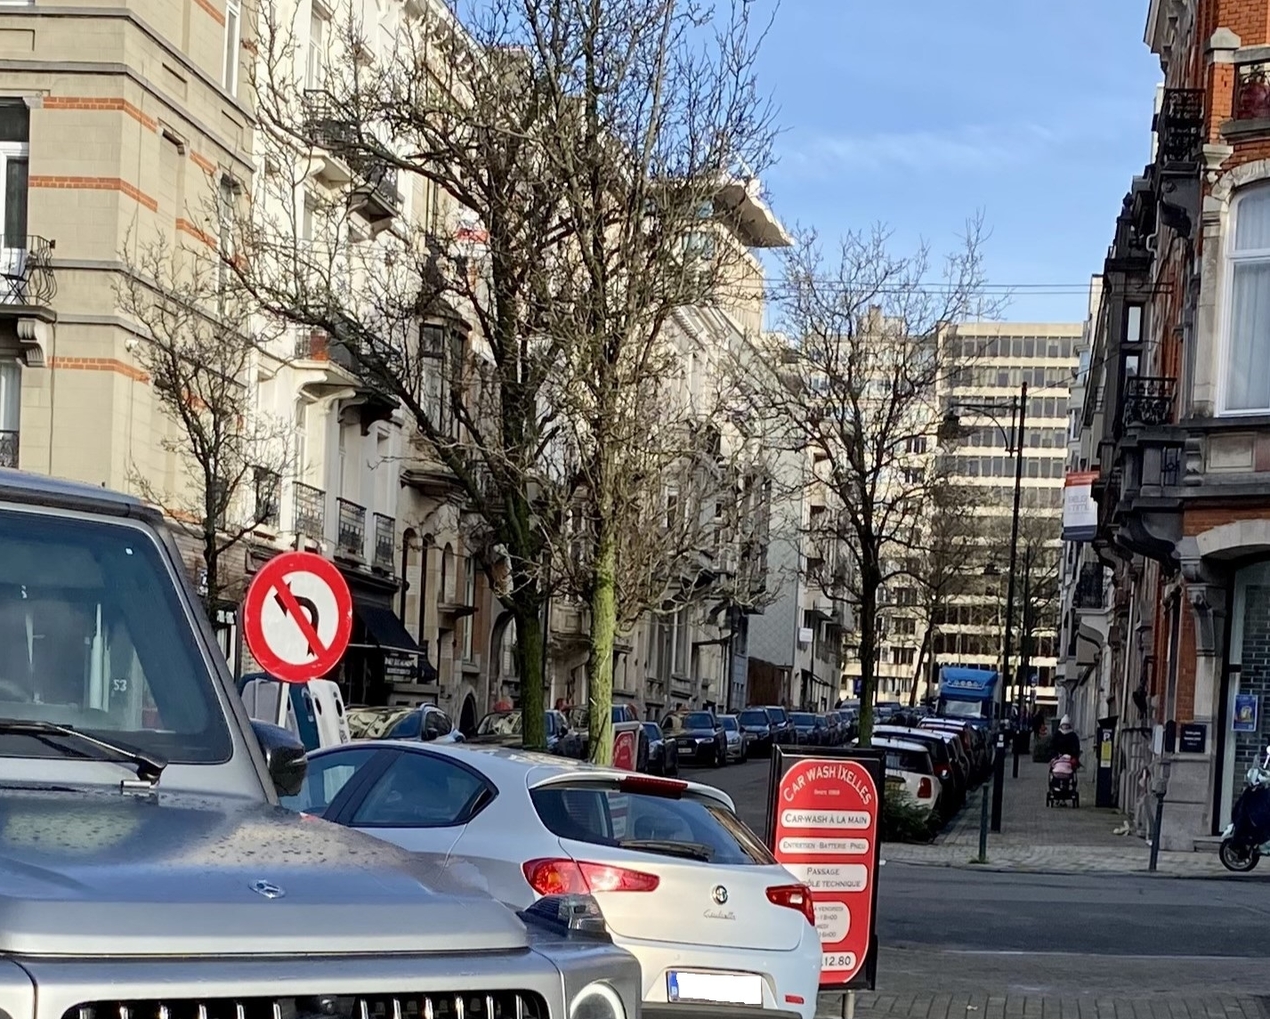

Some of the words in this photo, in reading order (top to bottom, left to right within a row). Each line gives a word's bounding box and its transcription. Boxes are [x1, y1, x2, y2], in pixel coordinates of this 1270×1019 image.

[783, 775, 806, 802] CAR
[806, 765, 836, 781] WASH
[837, 765, 872, 805] IXELLES
[836, 816, 846, 824] LA
[848, 817, 868, 825] MAIN
[807, 867, 840, 875] PASSAGE
